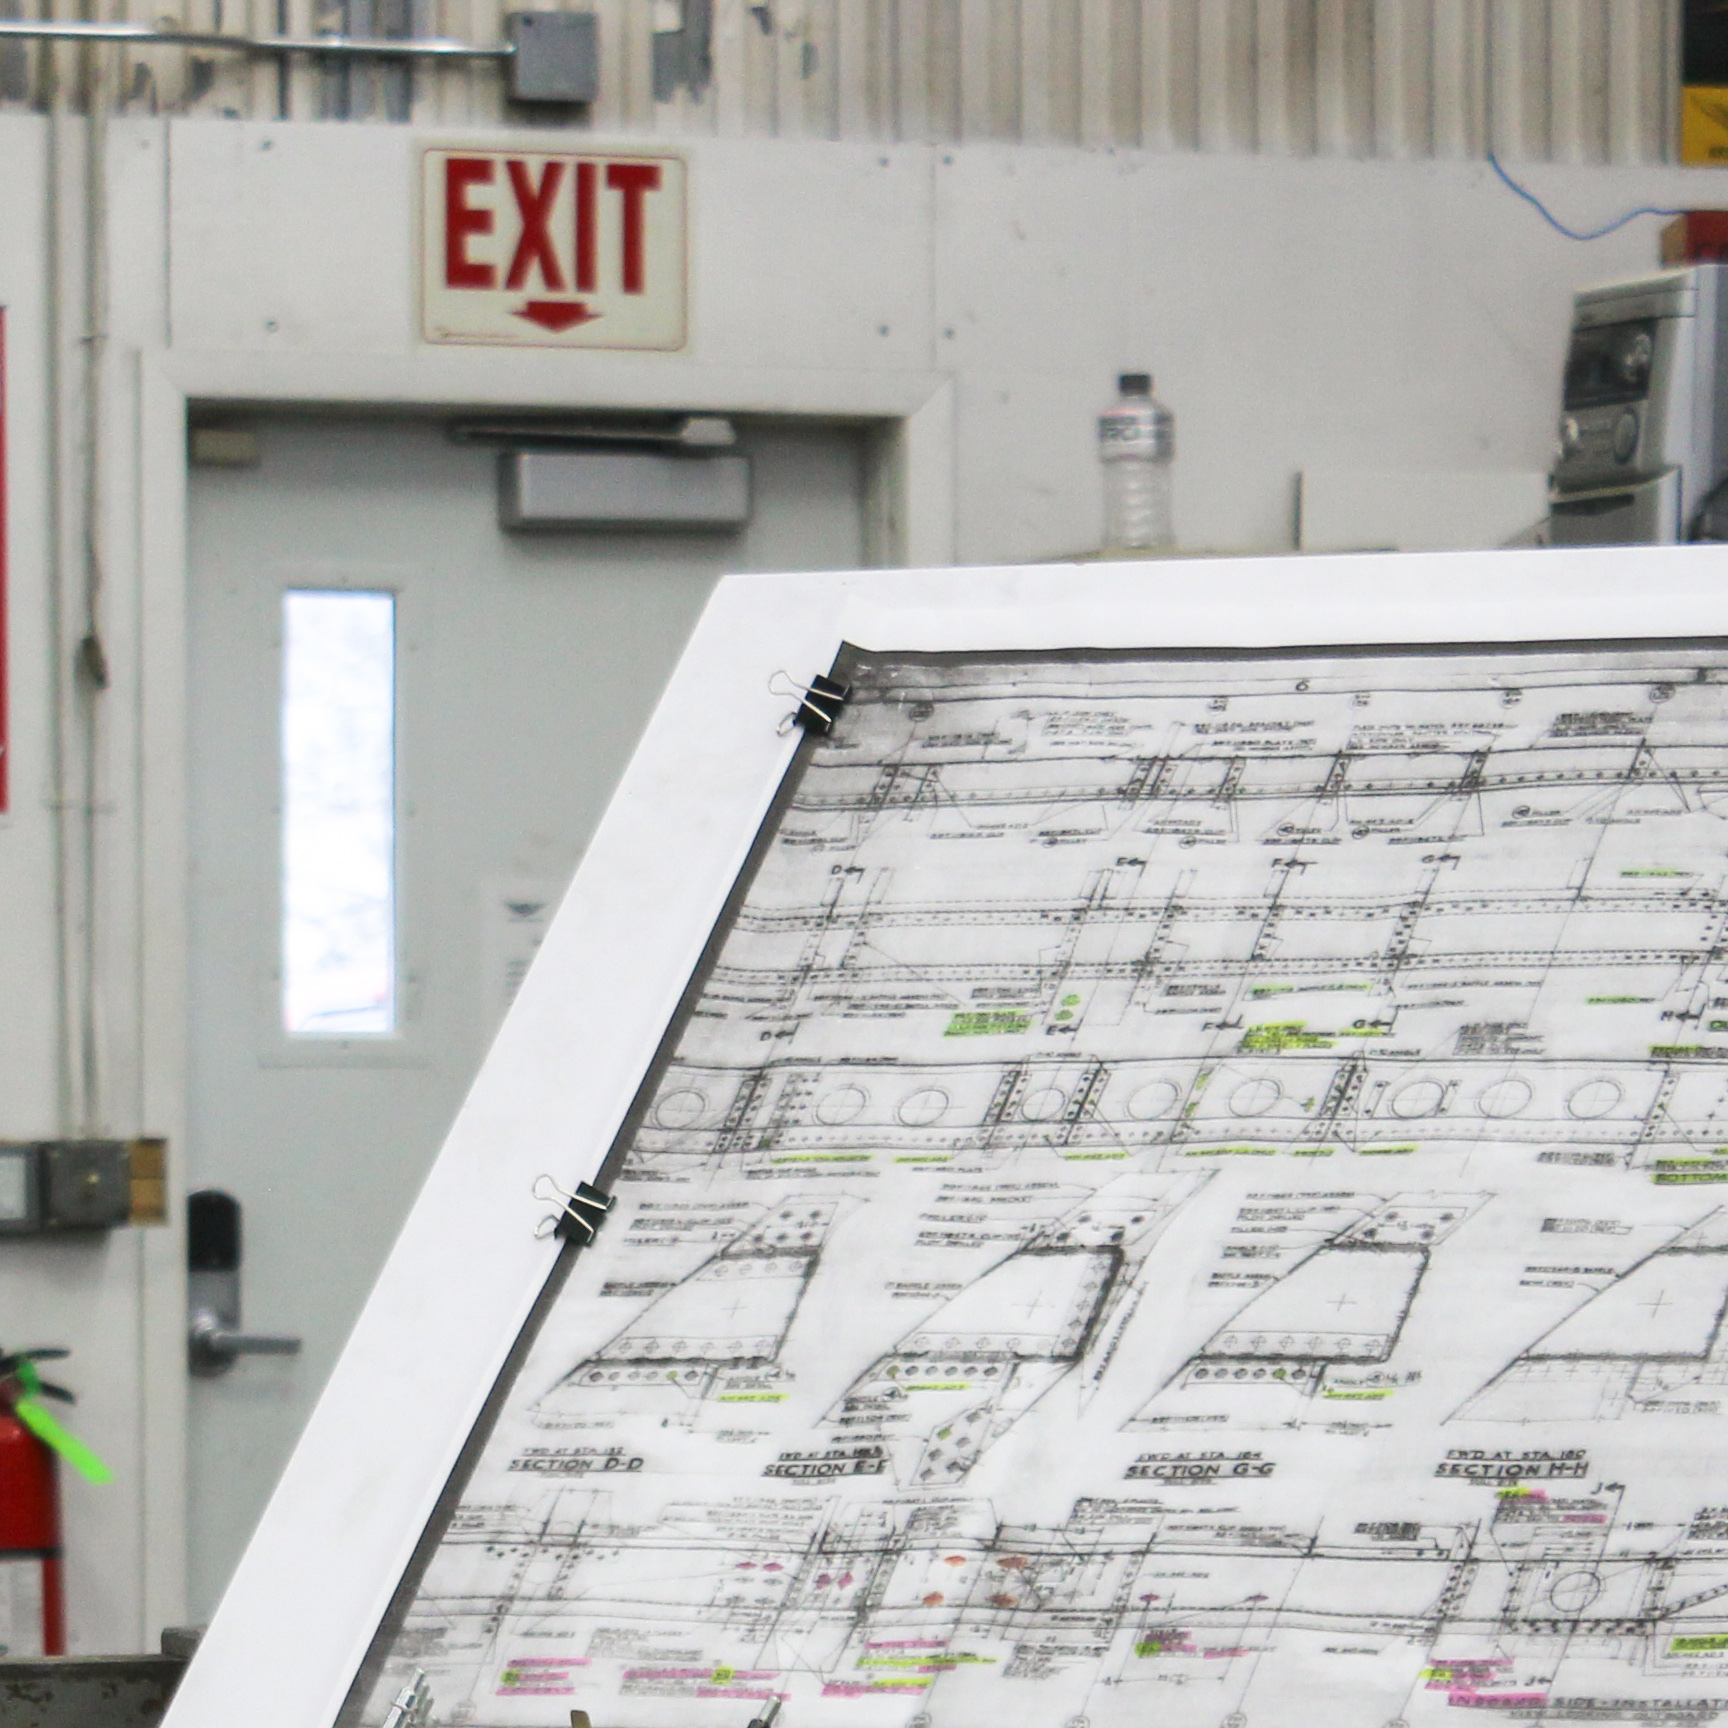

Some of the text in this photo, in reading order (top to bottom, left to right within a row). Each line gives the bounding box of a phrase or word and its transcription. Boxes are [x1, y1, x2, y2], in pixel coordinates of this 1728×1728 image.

[446, 158, 662, 294] EXIT
[1294, 679, 1310, 692] 6
[1654, 1172, 1728, 1184] BOTTOM
[1445, 1449, 1486, 1459] FWD
[1493, 1450, 1514, 1460] AT
[1522, 1450, 1551, 1460] STA
[507, 1456, 645, 1471] SECTION D-D
[762, 1463, 848, 1477] SECTION
[1124, 1462, 1276, 1478] SECTION G-G
[1434, 1460, 1590, 1477] SECTION H-H
